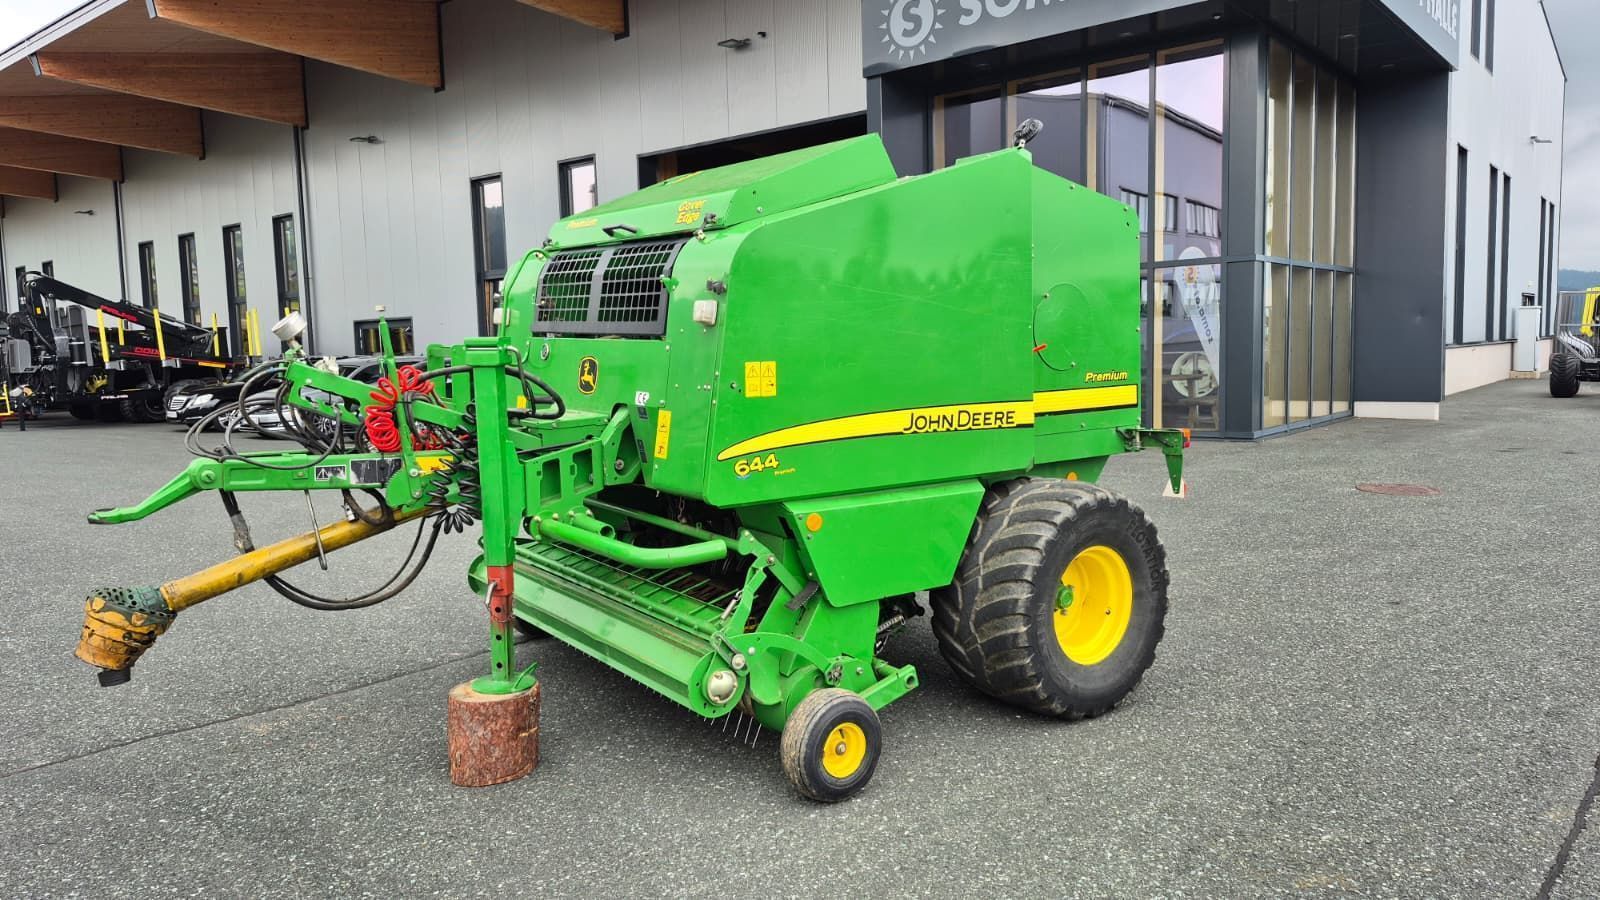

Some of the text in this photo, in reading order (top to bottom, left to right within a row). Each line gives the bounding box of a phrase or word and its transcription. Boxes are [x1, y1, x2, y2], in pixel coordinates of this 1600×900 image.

[1084, 370, 1128, 383] Premium
[903, 409, 1016, 432] JOHN DEERE
[734, 453, 779, 477] 644
[1126, 519, 1161, 592] FLOTATION
